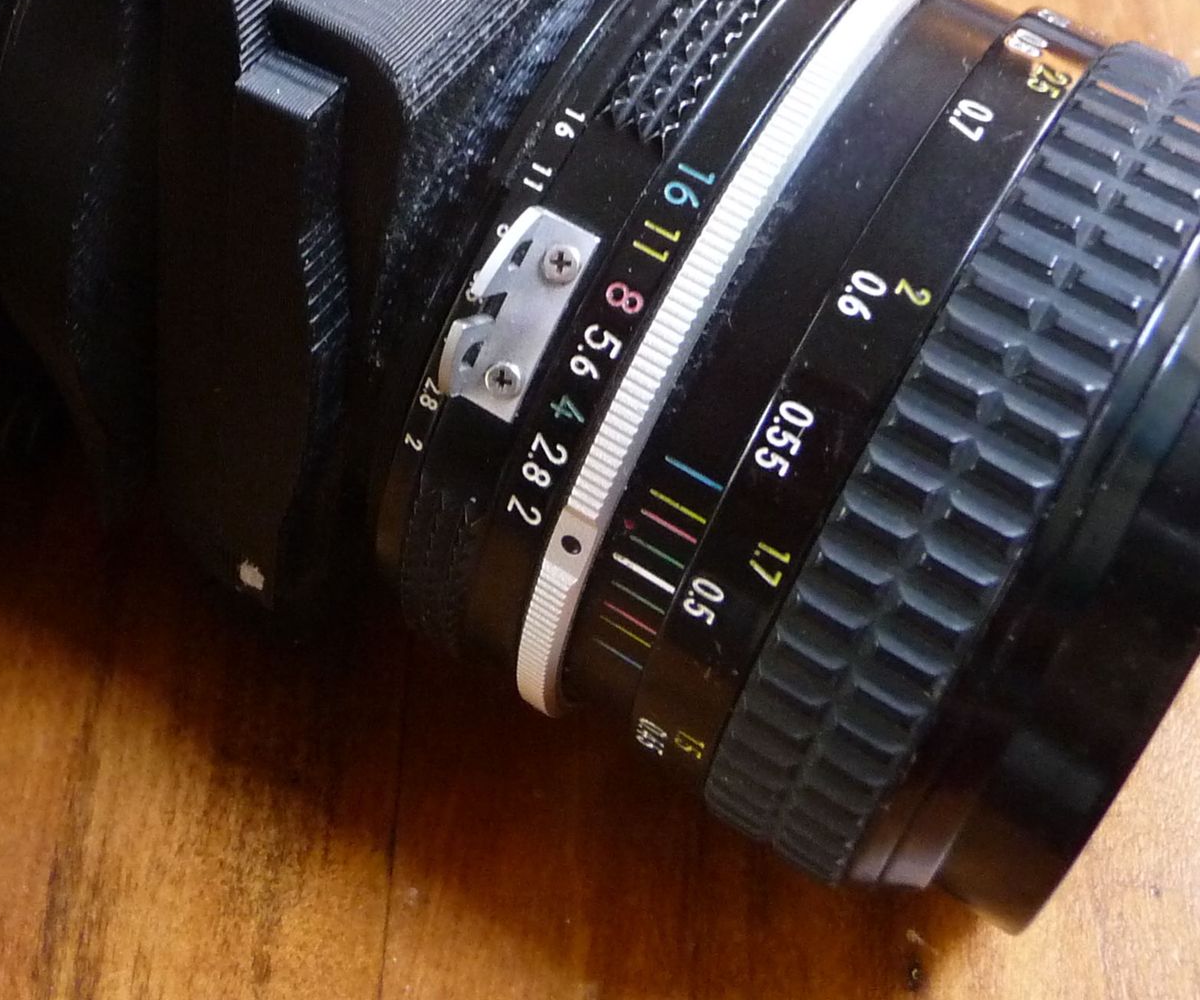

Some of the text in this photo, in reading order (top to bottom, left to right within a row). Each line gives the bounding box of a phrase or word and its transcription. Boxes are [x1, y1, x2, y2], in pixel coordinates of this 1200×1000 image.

[949, 99, 994, 142] 0.7
[523, 107, 586, 192] 16 11
[837, 270, 887, 321] 0.6
[894, 279, 932, 306] 2
[507, 163, 715, 526] 16 11 8 5.6 4 2.8 2
[404, 432, 423, 451] 2
[754, 400, 814, 477] 0.55
[749, 541, 791, 587] 1.7
[683, 576, 725, 625] 0.5
